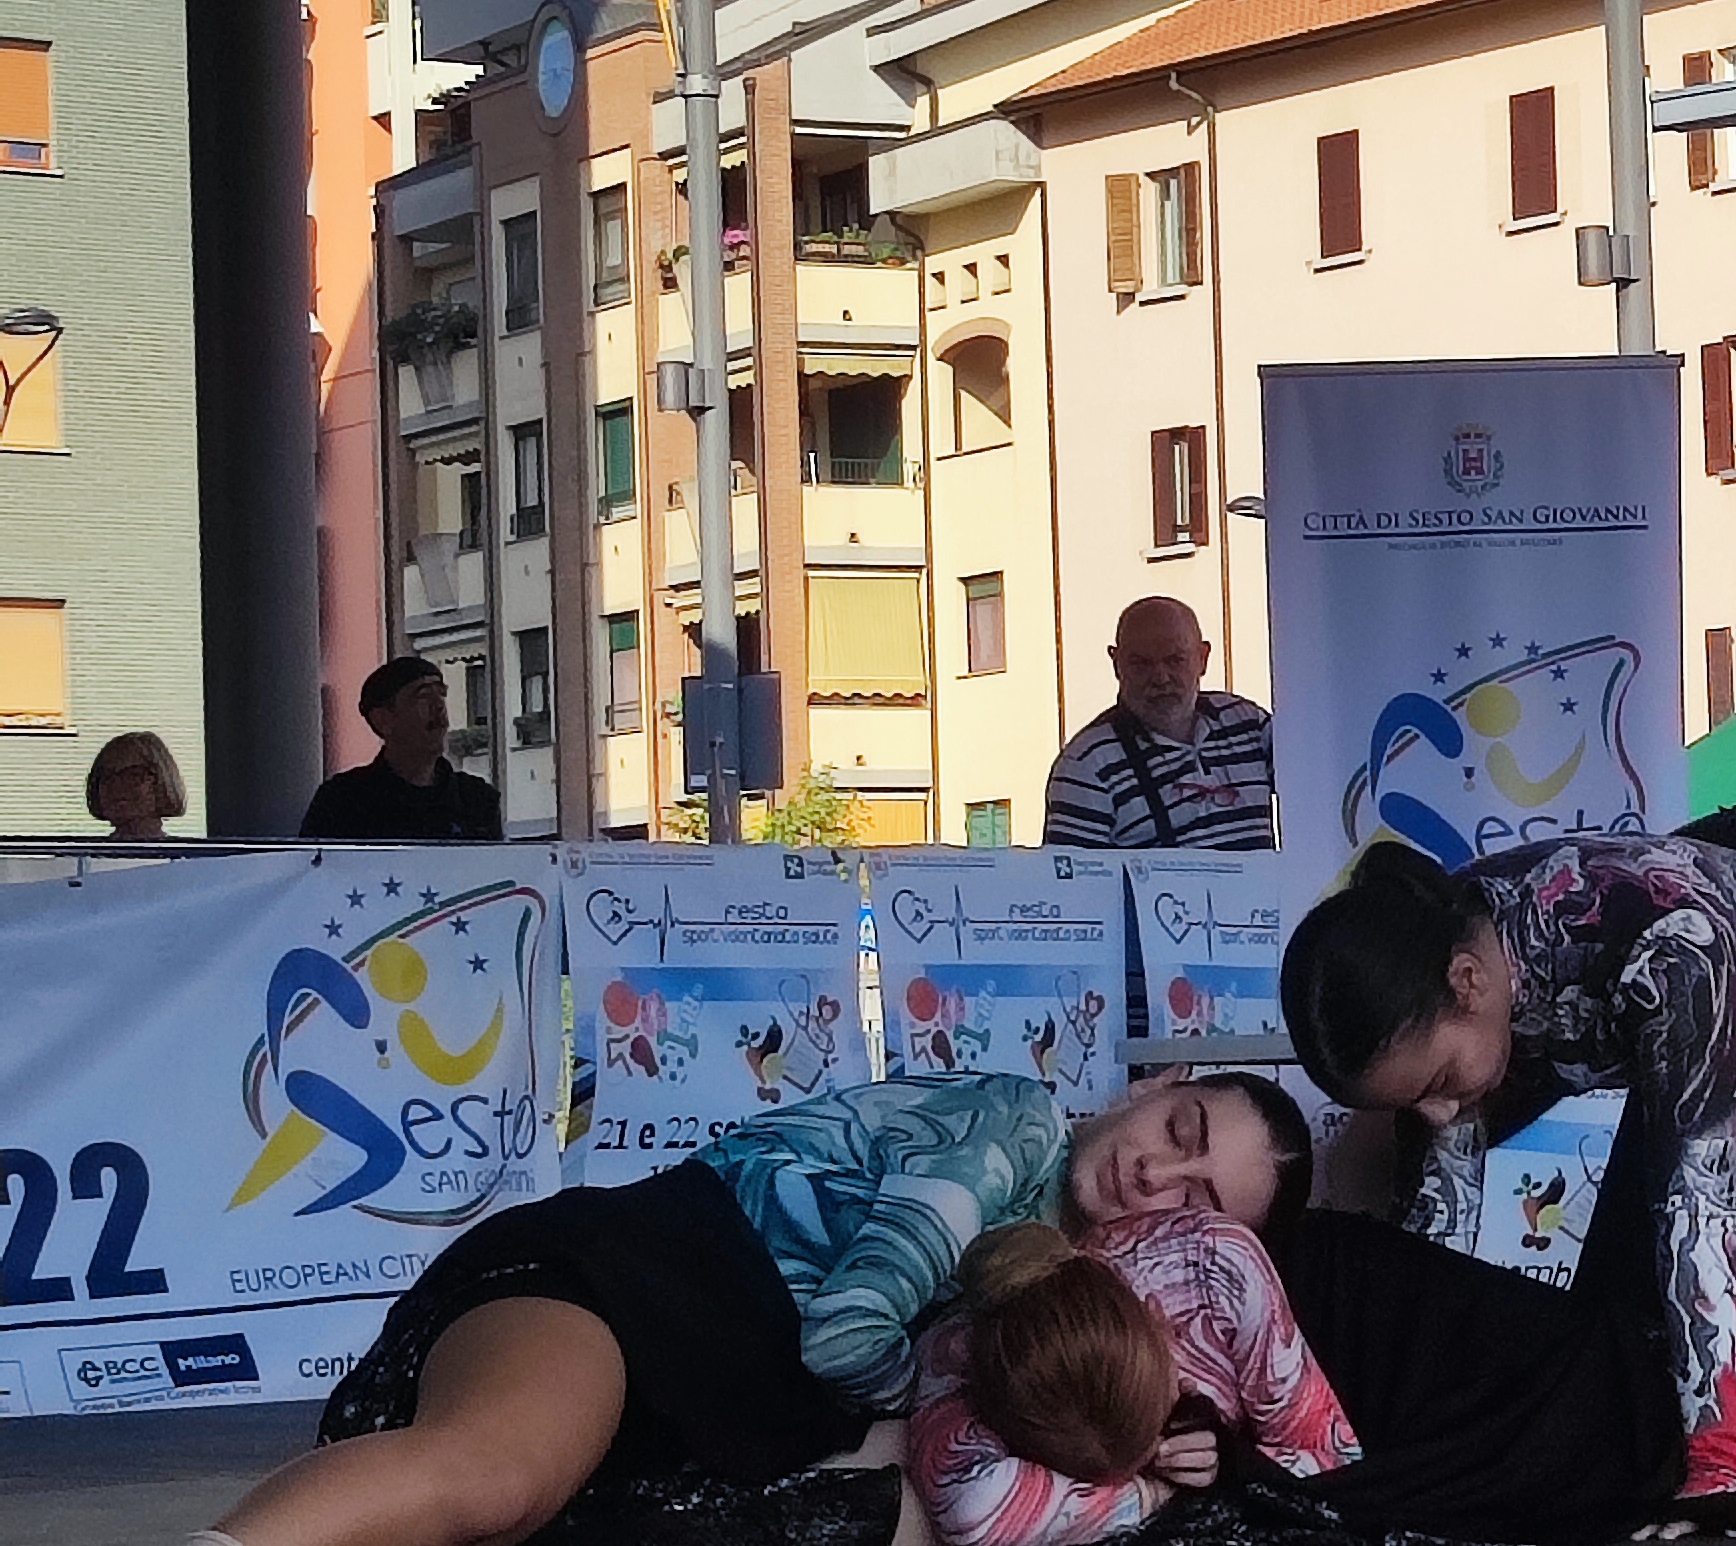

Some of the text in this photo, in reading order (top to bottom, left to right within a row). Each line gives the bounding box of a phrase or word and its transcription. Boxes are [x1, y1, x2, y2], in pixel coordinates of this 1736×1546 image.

[1303, 503, 1650, 532] CITTÀ DI SESTO SAN GIOVANNI
[593, 1116, 630, 1151] 21
[637, 1120, 657, 1151] e
[662, 1115, 700, 1151] 22
[228, 1260, 371, 1295] EUROPEAN
[103, 1356, 160, 1377] BCC
[177, 1353, 241, 1372] Milano
